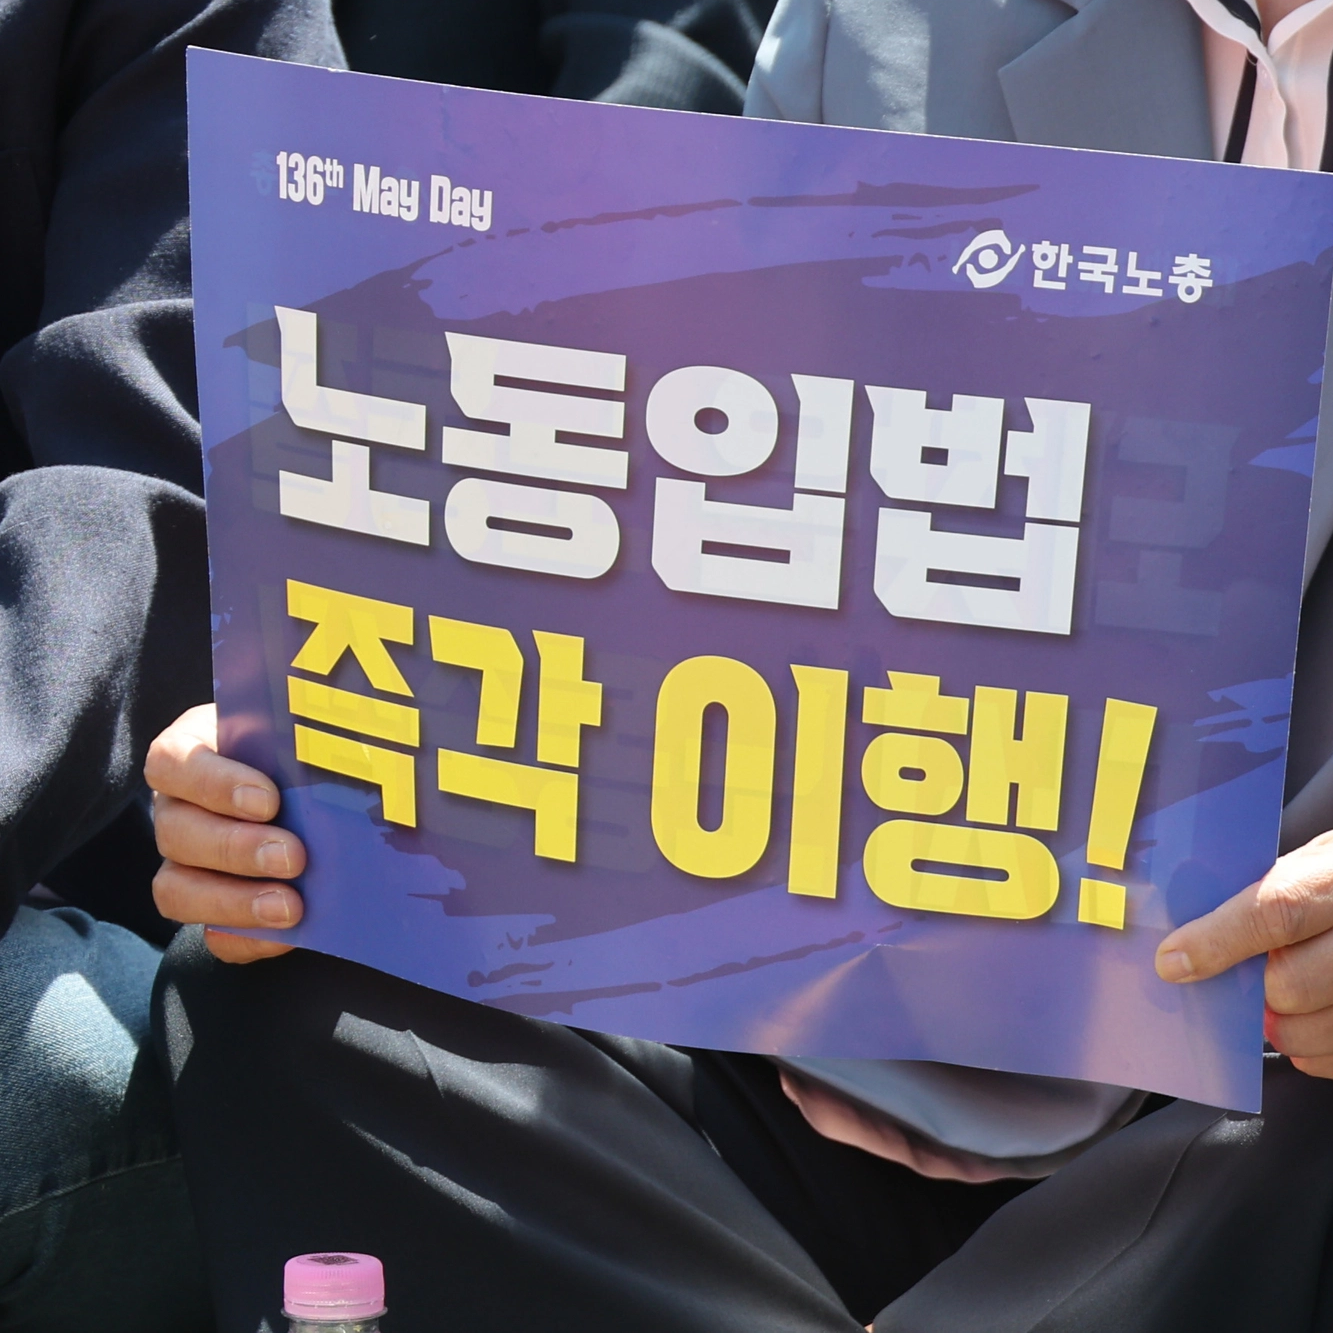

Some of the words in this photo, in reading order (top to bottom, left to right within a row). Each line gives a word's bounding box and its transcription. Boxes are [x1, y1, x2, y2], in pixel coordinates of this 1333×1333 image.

[275, 150, 344, 206] 136th
[352, 162, 420, 222] May
[429, 174, 493, 232] Day
[1031, 240, 1214, 304] 한국노총
[274, 305, 1093, 636] 노동입법
[286, 578, 603, 863] 즉각
[651, 655, 1158, 931] 이행!
